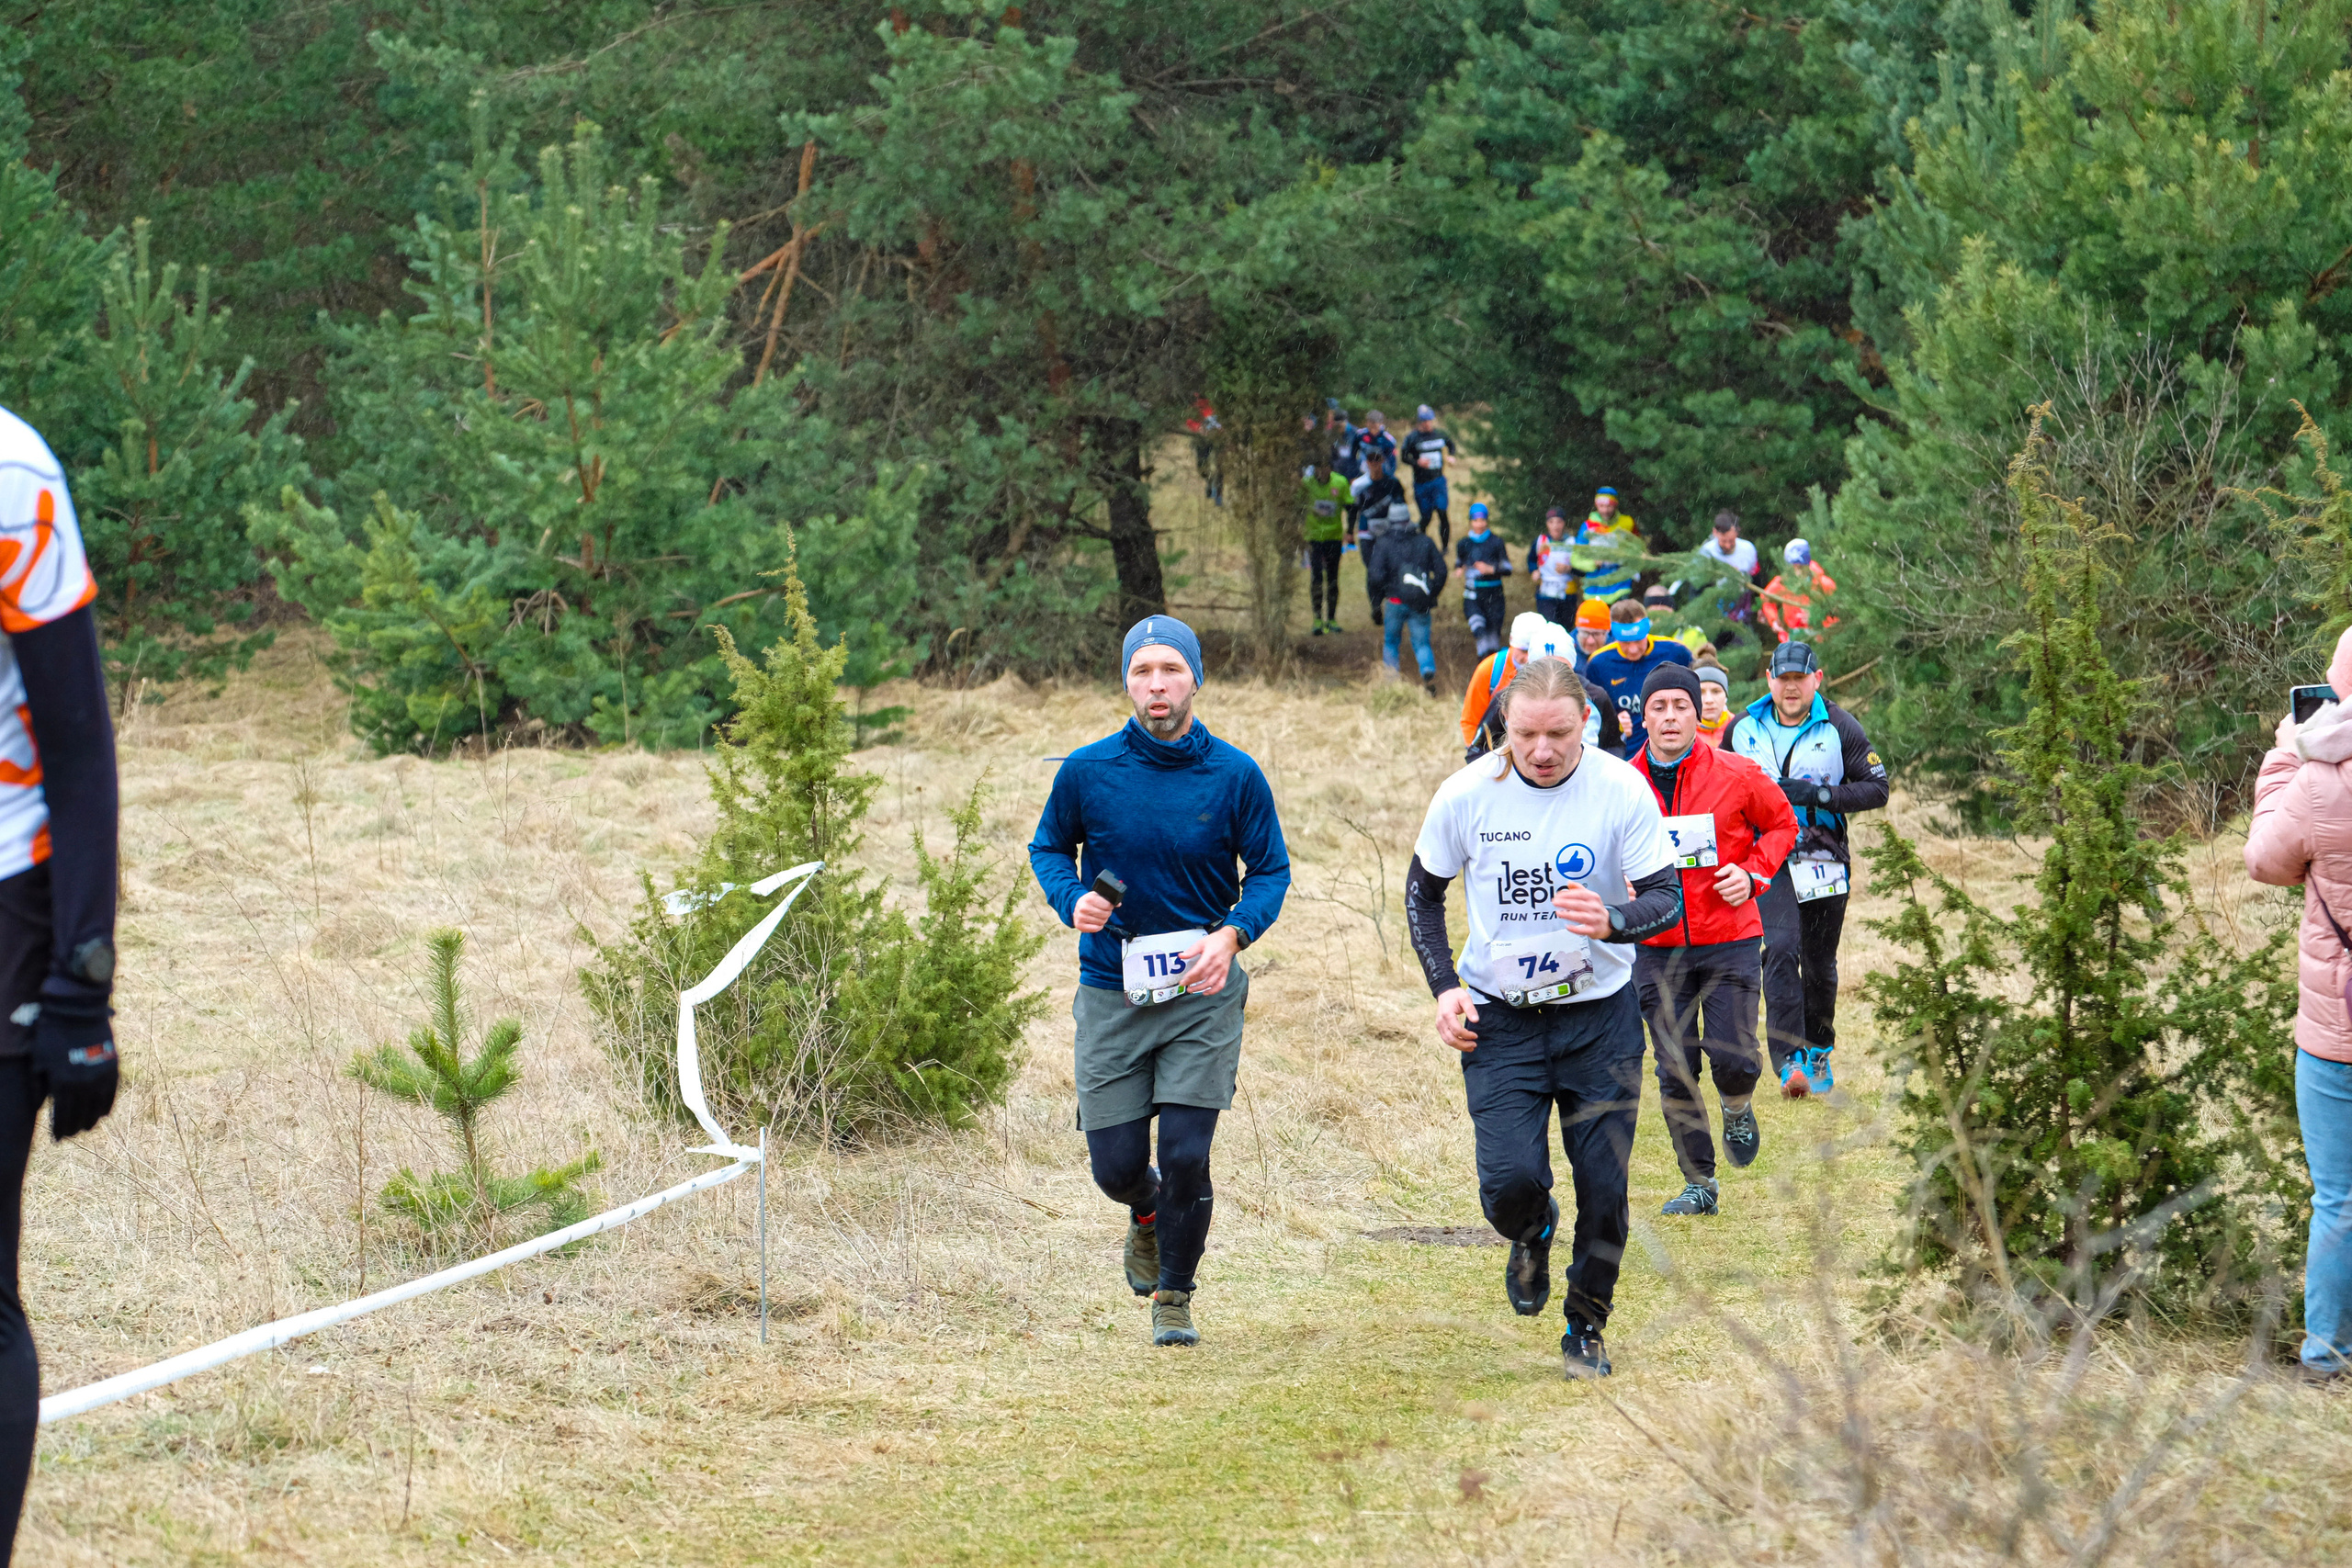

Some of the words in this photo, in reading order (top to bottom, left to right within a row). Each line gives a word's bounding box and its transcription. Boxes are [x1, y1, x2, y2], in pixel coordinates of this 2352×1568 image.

[1479, 830, 1532, 842] TUCANO
[1501, 861, 1554, 892] Jest
[1811, 864, 1826, 879] 11
[1500, 912, 1528, 921] RUN
[1532, 911, 1560, 921] TEA
[1143, 951, 1186, 977] 113
[1518, 951, 1560, 979] 74
